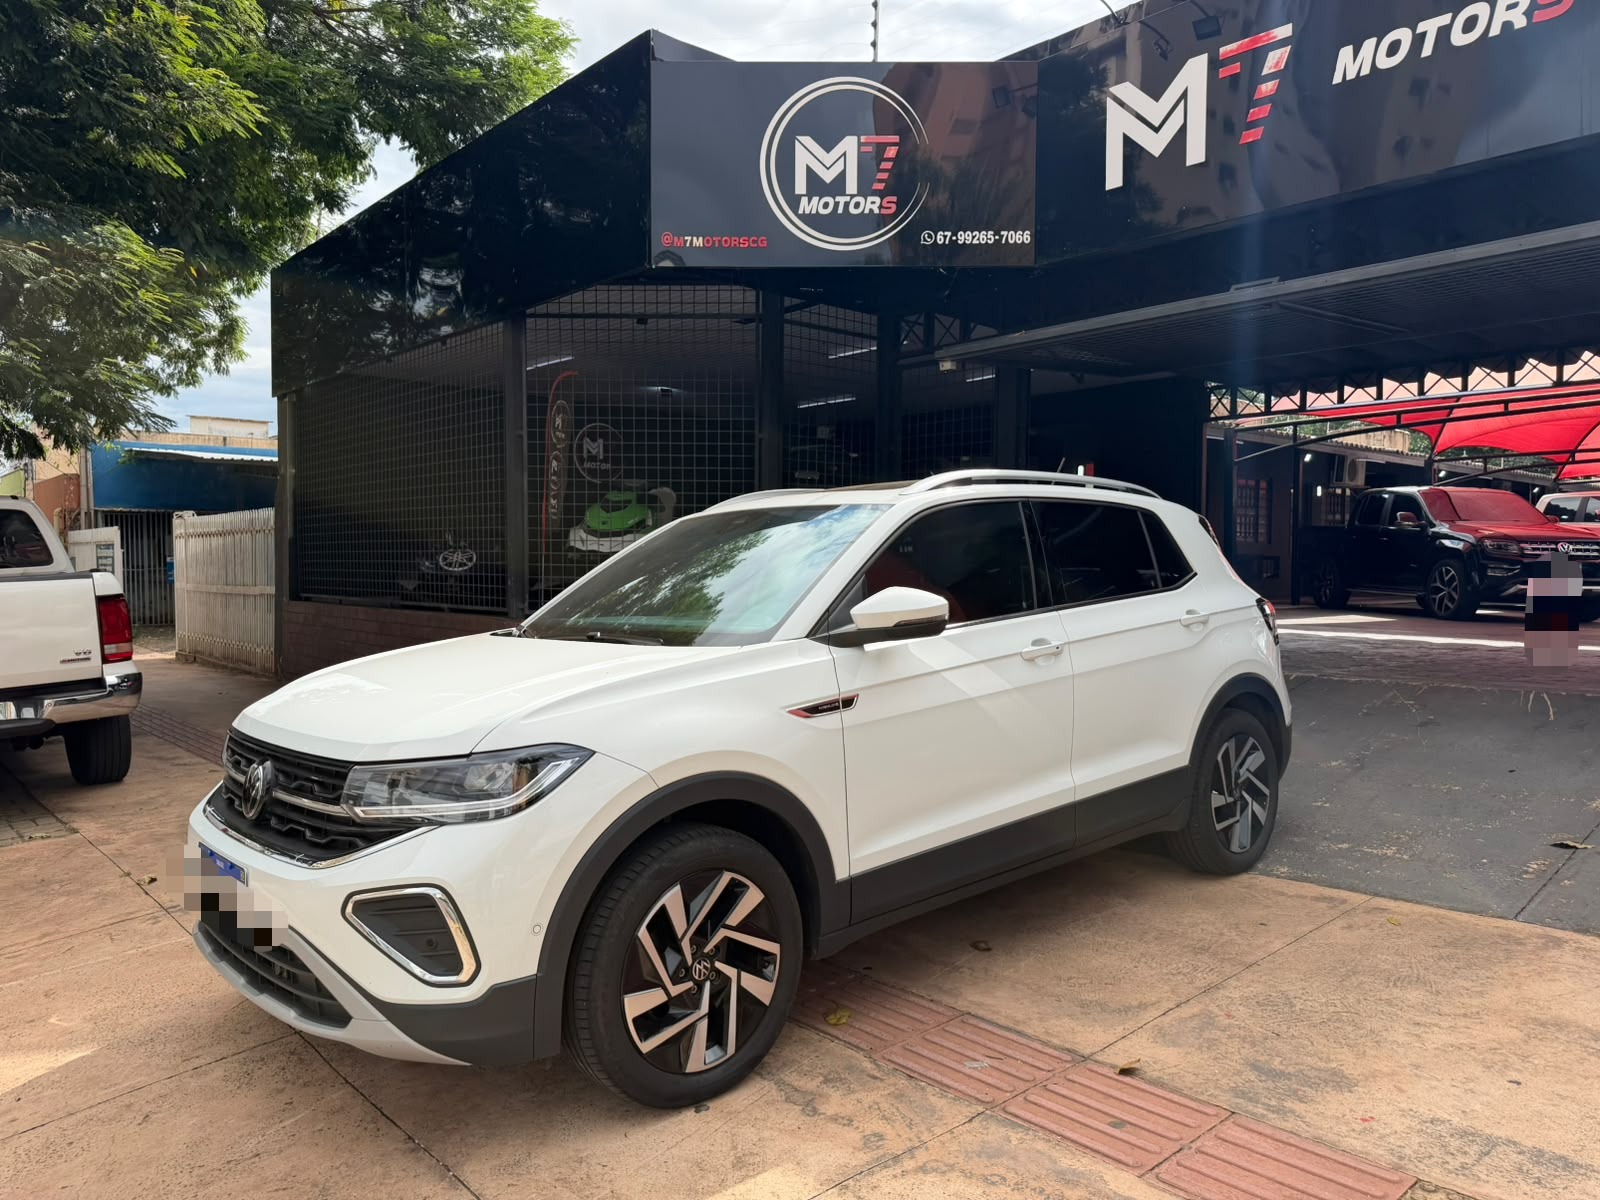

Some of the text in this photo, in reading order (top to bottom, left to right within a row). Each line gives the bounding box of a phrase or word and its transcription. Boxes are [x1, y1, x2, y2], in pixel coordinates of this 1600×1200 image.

[1105, 23, 1293, 191] M7
[794, 135, 900, 195] M7
[798, 195, 898, 215] MOTORS
[660, 231, 768, 248] @M7MOTORSCG
[936, 230, 1031, 245] 67-99265-7066
